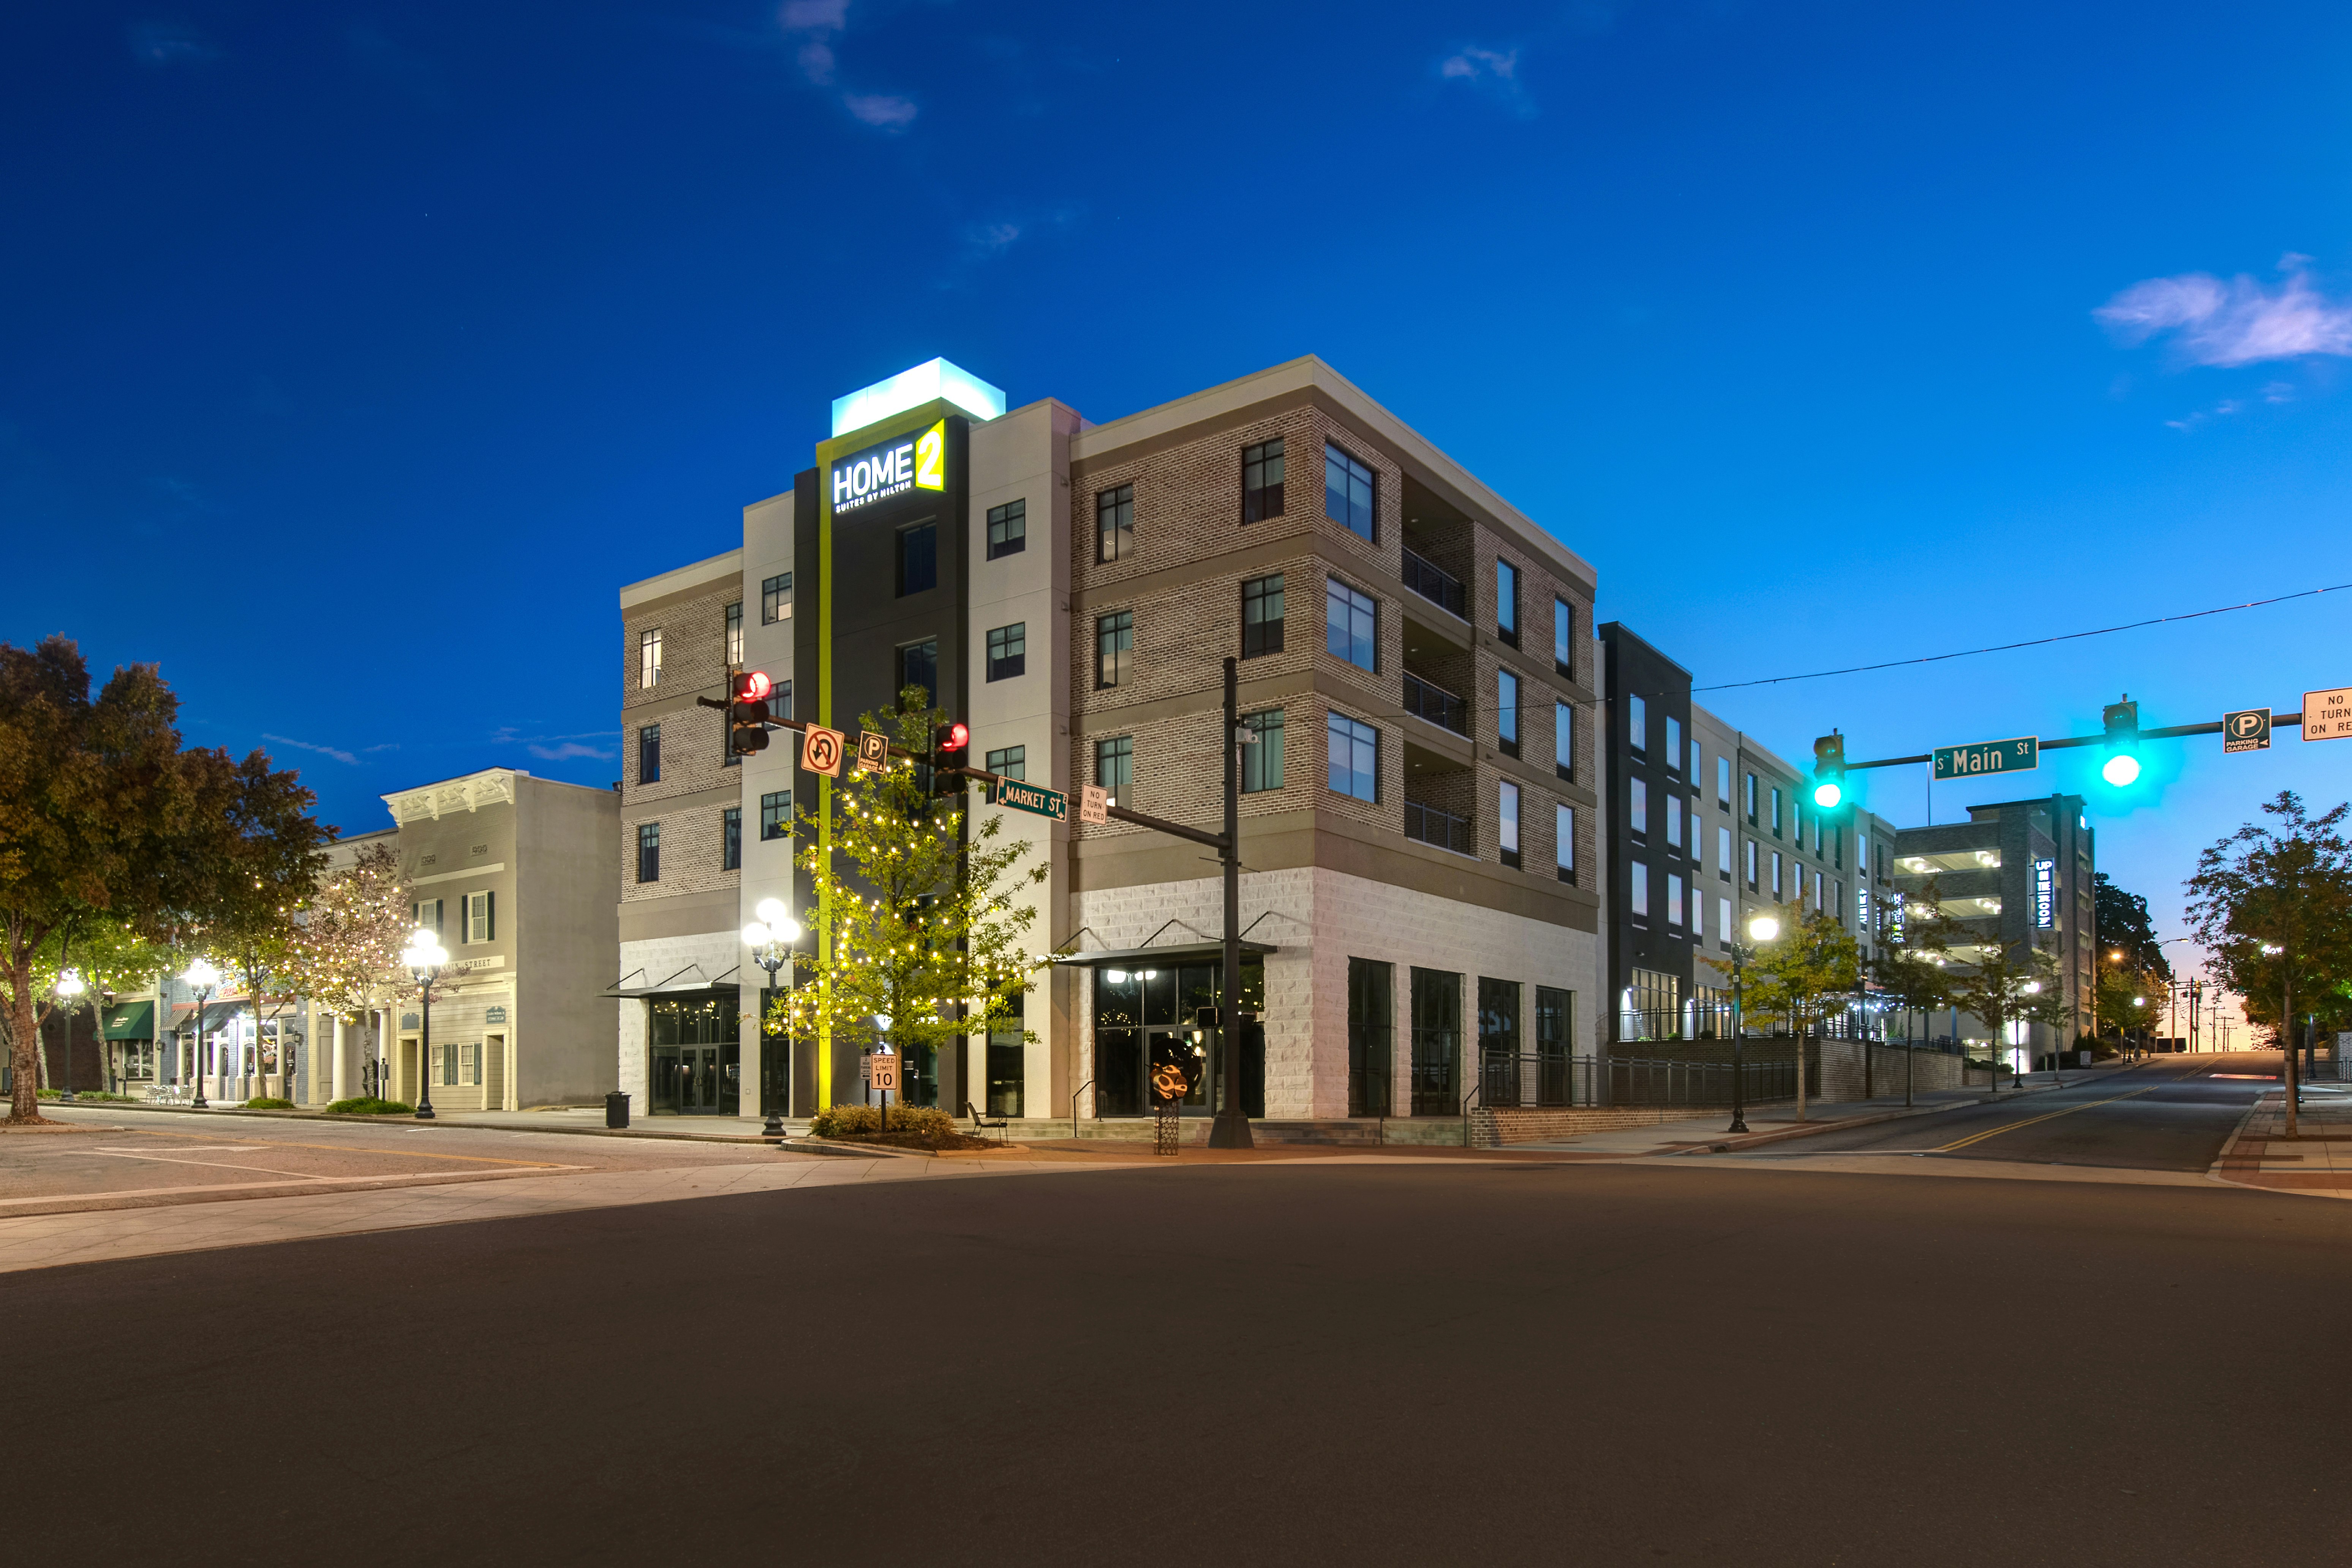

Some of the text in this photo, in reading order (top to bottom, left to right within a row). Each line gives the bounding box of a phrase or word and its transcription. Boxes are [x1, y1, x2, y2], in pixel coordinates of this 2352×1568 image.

[834, 431, 942, 503] HOME 2
[836, 480, 911, 514] SUITES BY HILTON
[2328, 695, 2343, 705] NO
[2321, 708, 2351, 719] TURN
[2239, 716, 2258, 735] P
[2311, 723, 2352, 734] ON RE
[869, 739, 880, 756] P
[2226, 738, 2259, 747] PARKING
[2226, 743, 2259, 752] GARAGE
[860, 757, 879, 766] PARKING
[1938, 742, 2029, 774] S Main St
[859, 763, 878, 771] GARAGE
[999, 778, 1067, 813] W MARKET ST E
[1090, 790, 1100, 799] NO
[1087, 800, 1102, 809] TURN
[1083, 810, 1104, 820] ON RED
[2036, 861, 2052, 871] UP
[465, 959, 491, 968] STREET
[876, 1073, 892, 1086] 10
